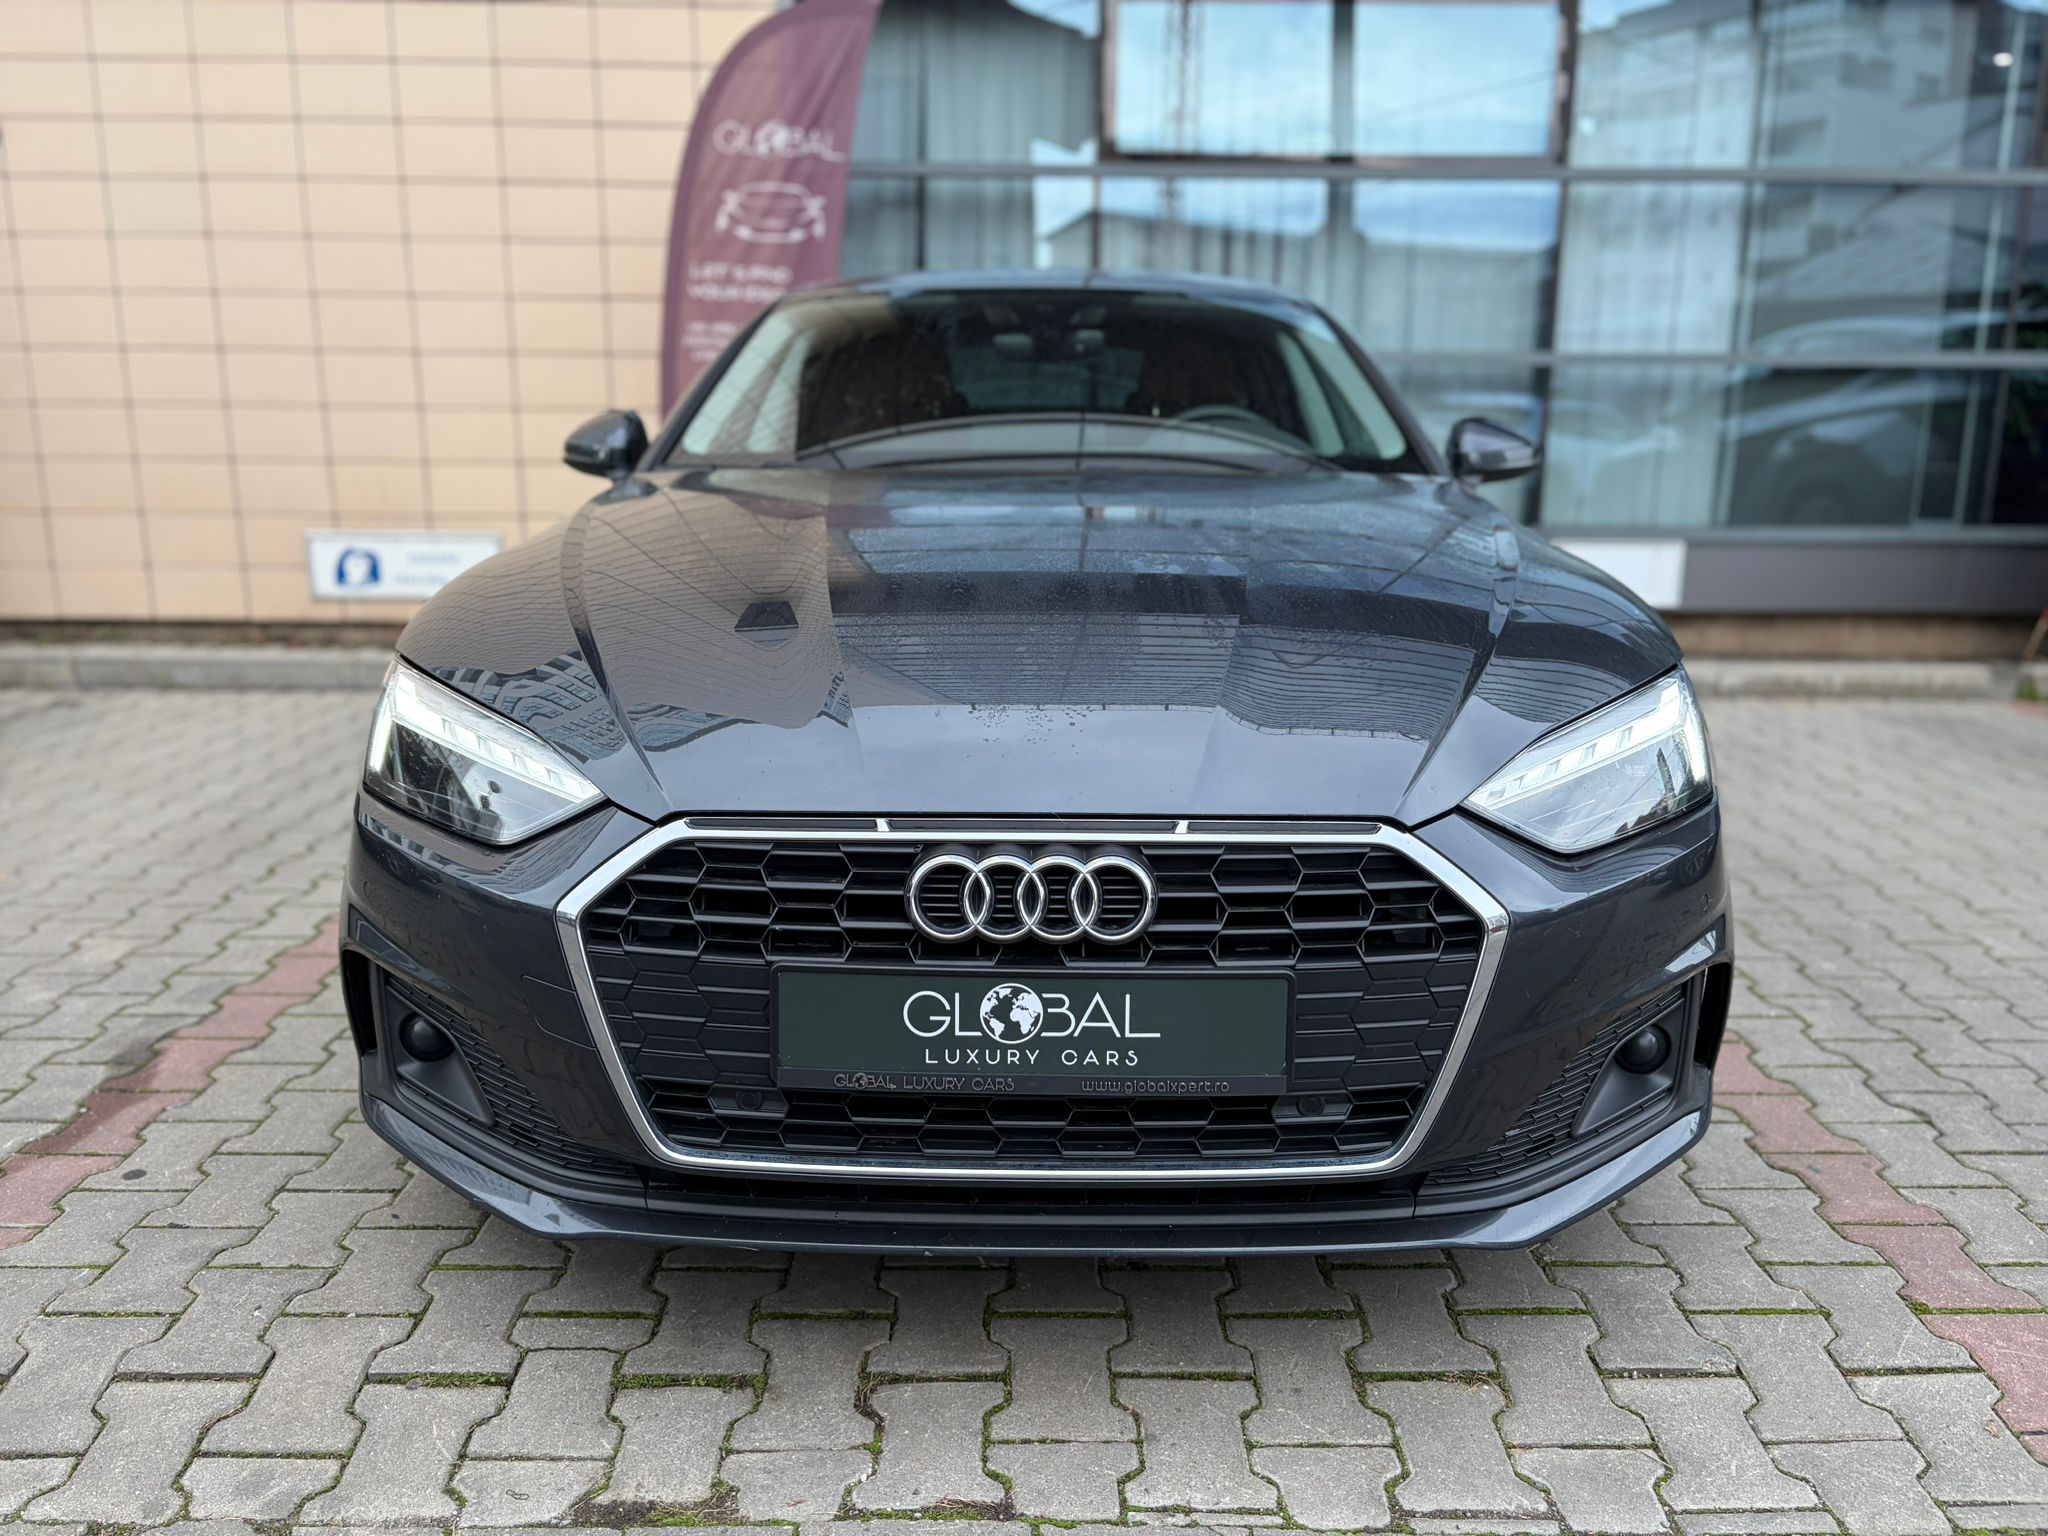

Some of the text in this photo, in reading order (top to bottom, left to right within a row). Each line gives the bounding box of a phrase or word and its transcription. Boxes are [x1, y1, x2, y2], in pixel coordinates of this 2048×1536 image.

[902, 982, 1162, 1045] GLOBAL
[925, 1048, 1140, 1067] LUXURY CARS
[833, 1072, 1015, 1092] GLOBAL LUXURY CARS
[1081, 1080, 1231, 1095] www.globalxpert.ro
